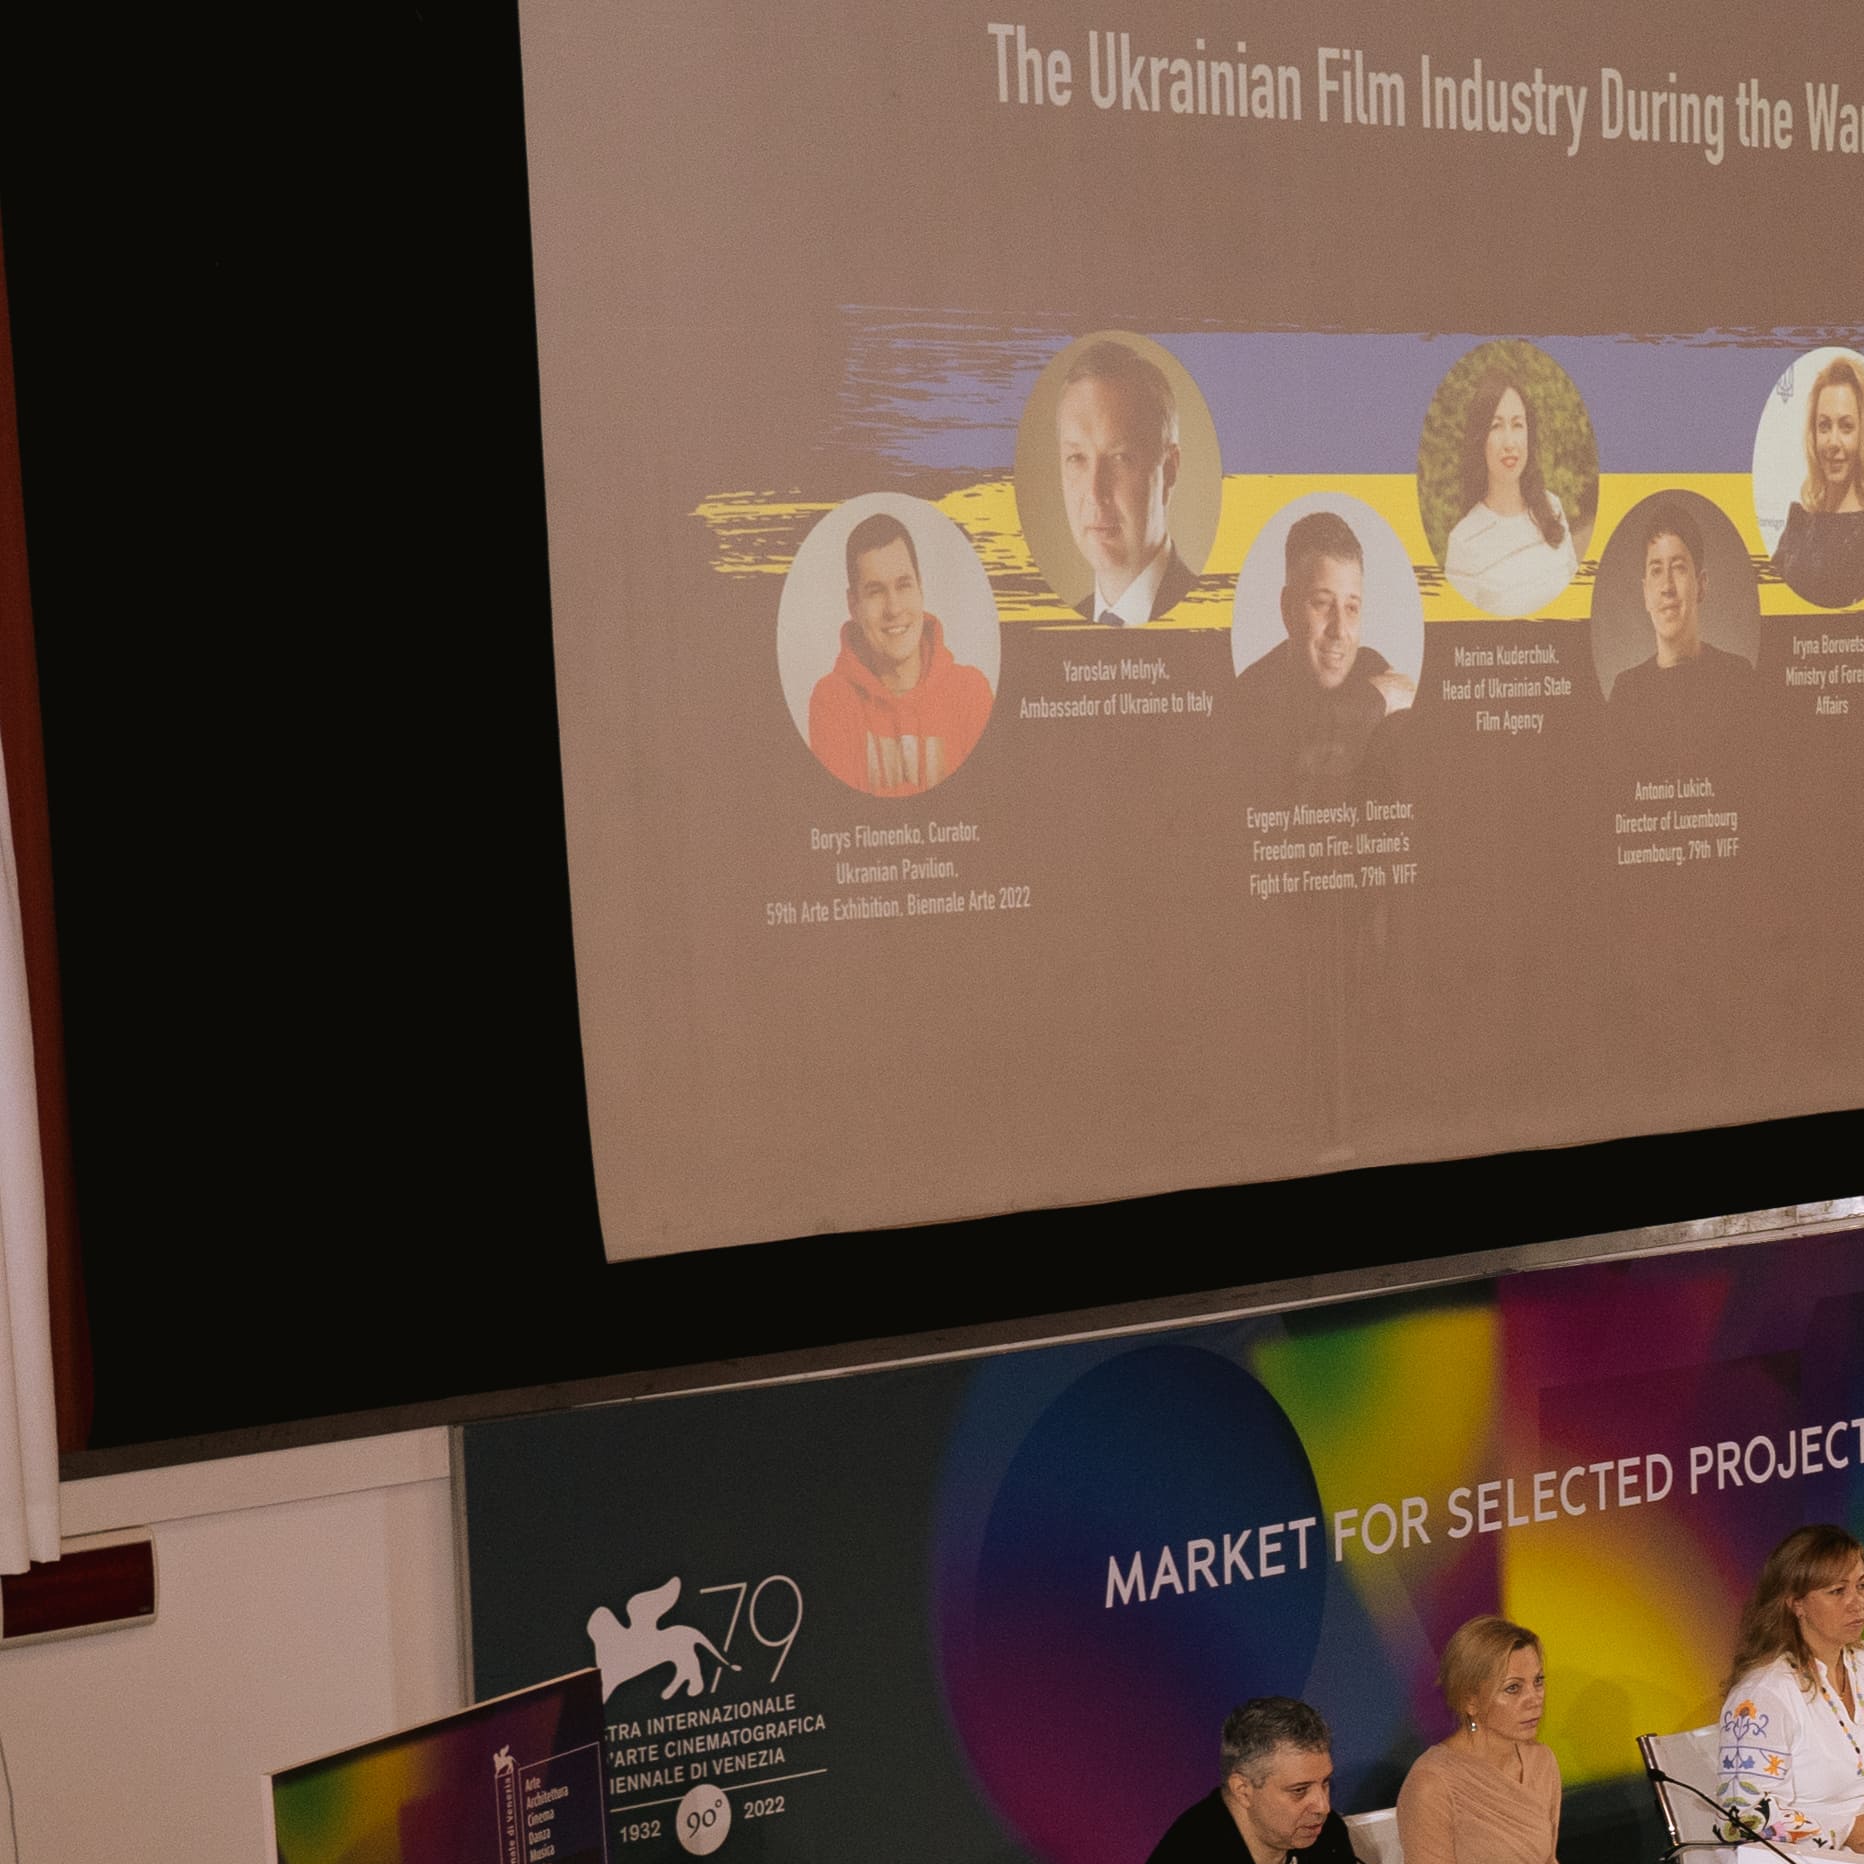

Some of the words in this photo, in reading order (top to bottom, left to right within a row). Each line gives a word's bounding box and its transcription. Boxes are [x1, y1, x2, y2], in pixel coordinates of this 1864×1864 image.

[988, 23, 1072, 106] The
[1089, 30, 1301, 120] Ukrainian
[1318, 47, 1405, 126] Film
[1421, 54, 1588, 157] Industry
[1601, 67, 1724, 165] During
[1737, 78, 1793, 149] the
[1454, 646, 1494, 667] Marina
[1793, 635, 1819, 660] Iryna
[1063, 660, 1117, 683] Yaroslav
[1785, 666, 1826, 690] Ministry
[1828, 664, 1839, 684] of
[1442, 678, 1471, 700] Head
[1474, 678, 1485, 699] of
[1488, 676, 1541, 699] Ukrainian
[1544, 675, 1572, 696] State
[1020, 695, 1101, 719] Ambassador
[1103, 693, 1117, 716] of
[1120, 692, 1168, 715] Ukraine
[1171, 693, 1184, 714] to
[1187, 690, 1214, 718] Italy
[1815, 695, 1849, 715] Affairs
[1476, 711, 1500, 731] Film
[1503, 710, 1544, 735] Agency
[1635, 781, 1674, 801] Antonio
[1246, 806, 1290, 833] Evgeny
[1615, 813, 1658, 834] Director
[1660, 810, 1671, 831] of
[1673, 808, 1738, 832] Luxembourg
[811, 828, 851, 855] Borys
[1253, 839, 1306, 862] Freedom
[1308, 841, 1324, 857] on
[1326, 835, 1354, 857] Fire:
[1356, 831, 1410, 855] Ukraine's
[1688, 840, 1711, 860] 79th
[1716, 837, 1740, 858] VIFF
[836, 860, 898, 884] Ukranian
[1250, 873, 1280, 900] Fight
[1282, 872, 1300, 893] for
[1360, 866, 1386, 888] 79th
[1392, 863, 1418, 885] VIFF
[766, 901, 797, 925] 59th
[801, 901, 829, 922] Arte
[907, 890, 965, 916] Biennale
[969, 890, 995, 911] Arte
[999, 885, 1031, 909] 2022
[1104, 1517, 1316, 1608] MARKET
[1334, 1495, 1432, 1562] FOR
[1446, 1454, 1672, 1539] SELECTED
[700, 1574, 804, 1694] 79
[647, 1693, 796, 1736] INTERNAZIONALE
[664, 1714, 826, 1760] CINEMATOGRAFICA
[610, 1765, 685, 1795] IENNALE
[691, 1760, 708, 1780] DI
[712, 1747, 786, 1778] VENEZIA
[620, 1820, 662, 1843] 1932
[744, 1796, 785, 1819] 2022
